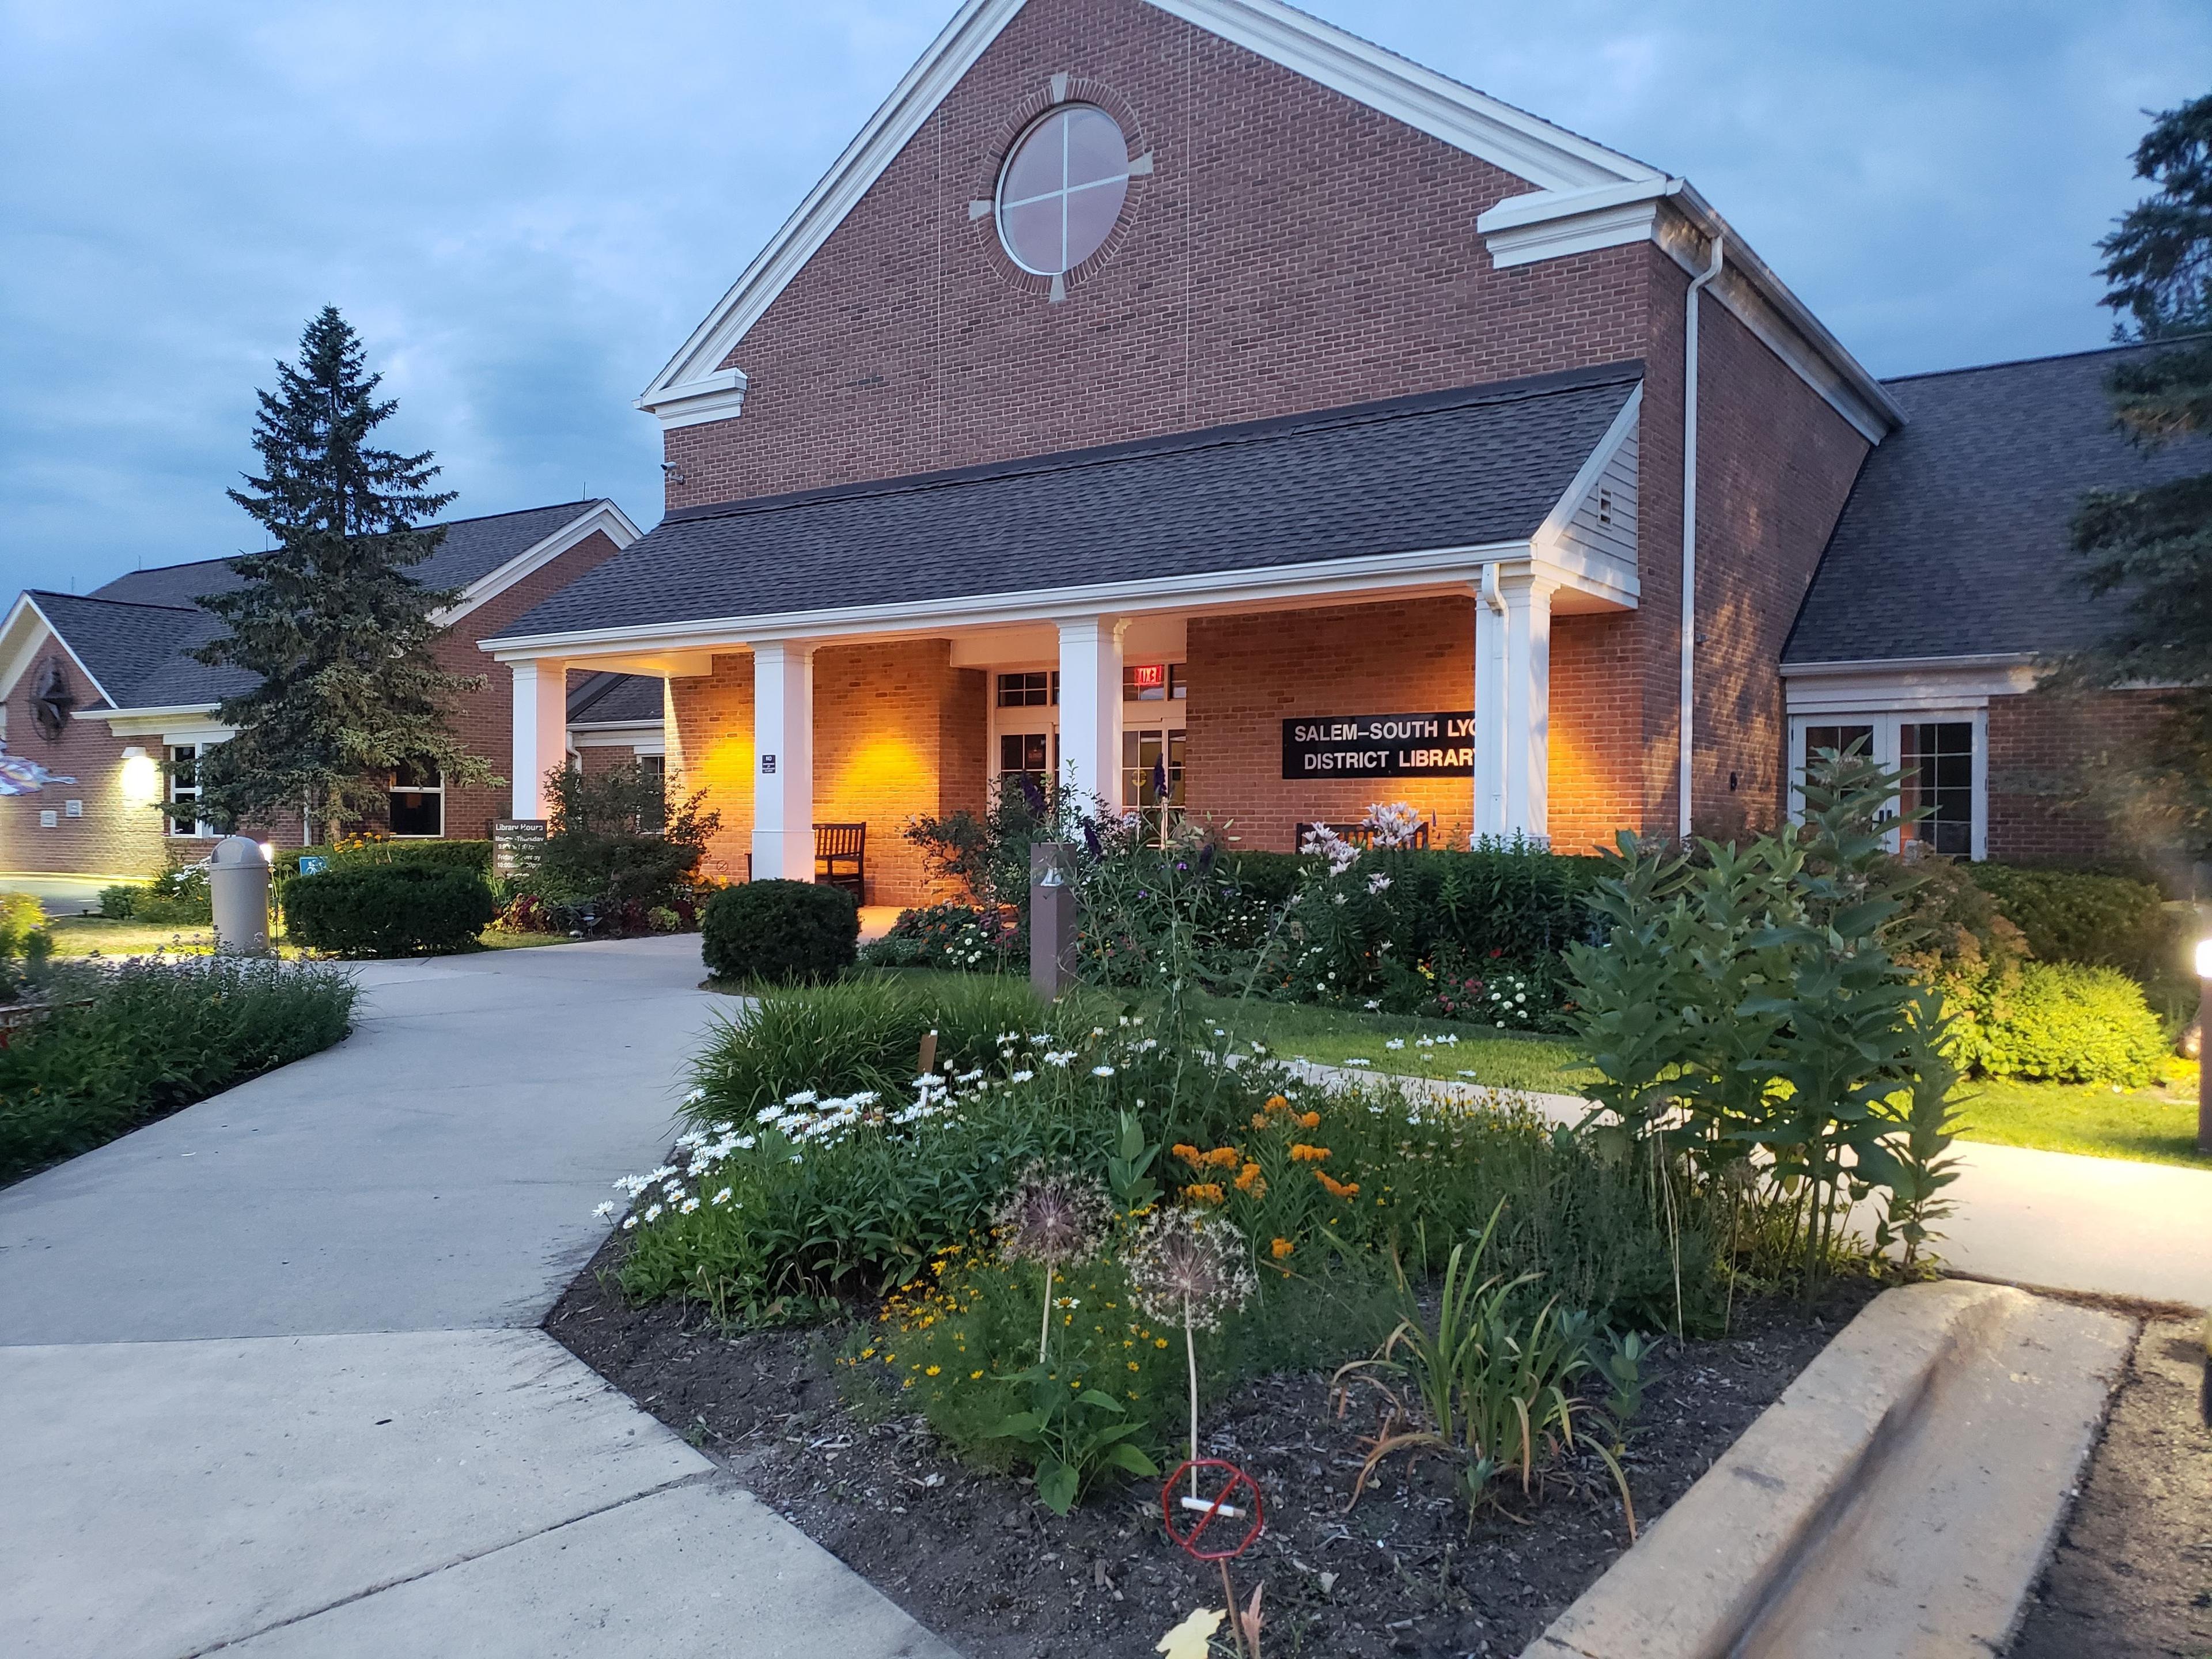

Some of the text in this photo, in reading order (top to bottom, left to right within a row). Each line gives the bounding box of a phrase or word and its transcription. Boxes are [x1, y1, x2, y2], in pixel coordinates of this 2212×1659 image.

[1294, 721, 1438, 742] SALEM-SOUTH
[1304, 748, 1475, 770] DISTRICT LIBRAR
